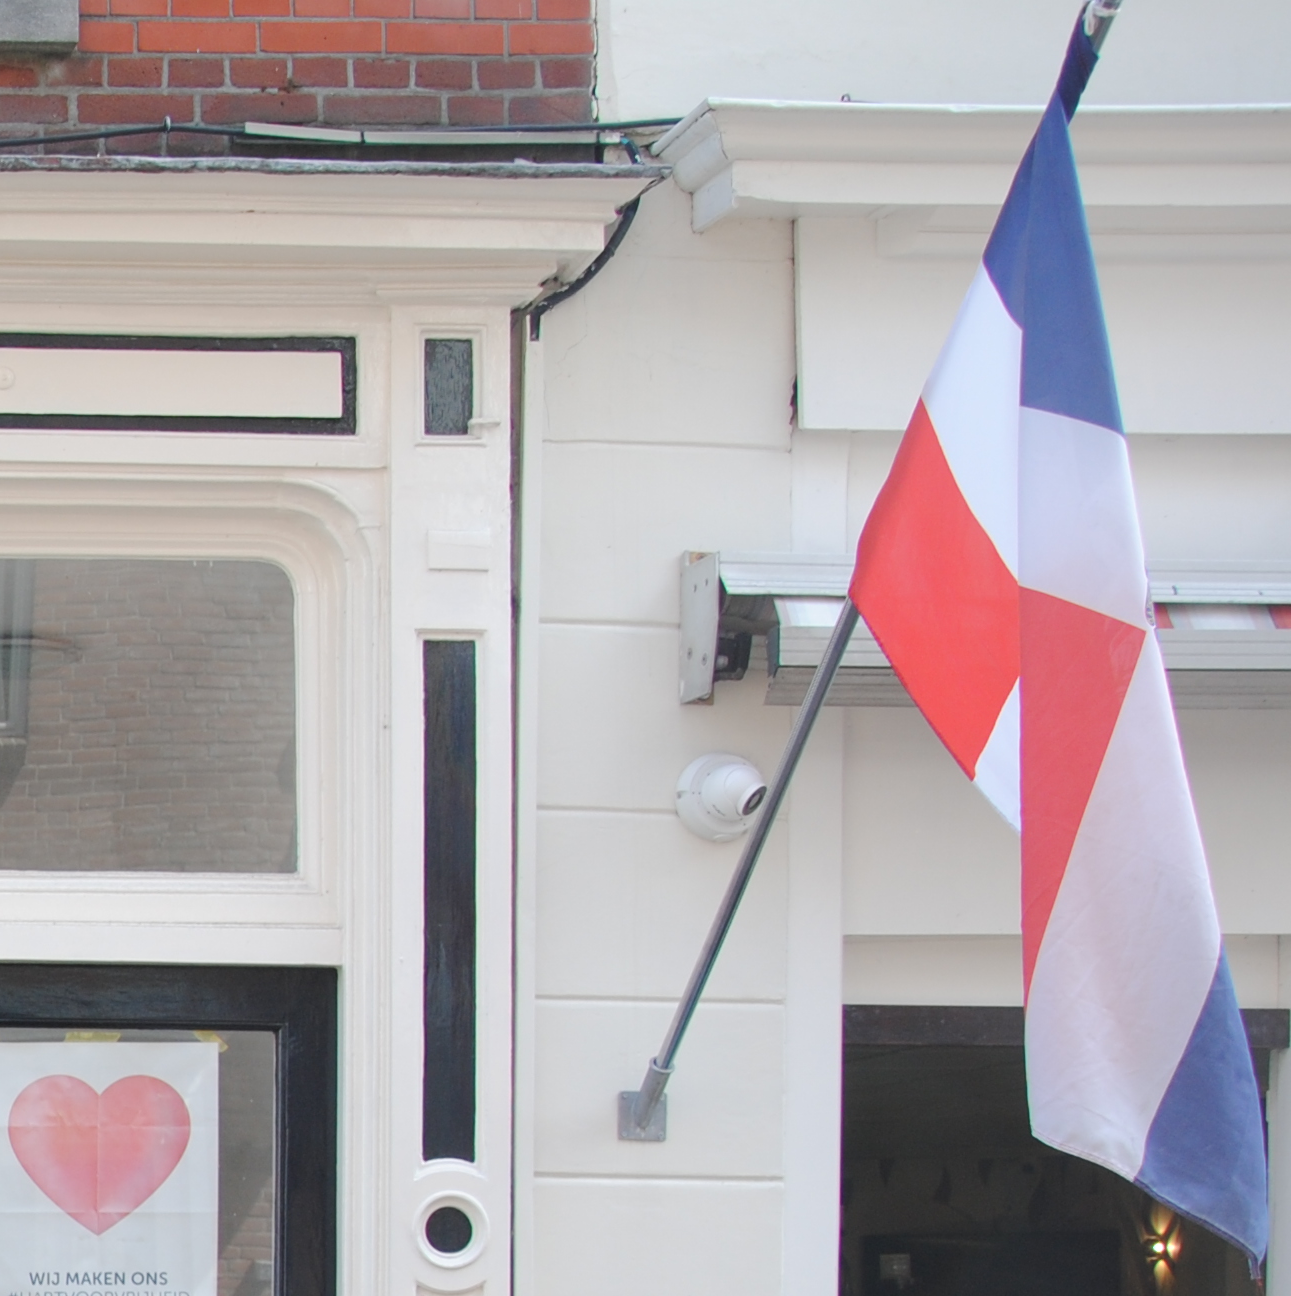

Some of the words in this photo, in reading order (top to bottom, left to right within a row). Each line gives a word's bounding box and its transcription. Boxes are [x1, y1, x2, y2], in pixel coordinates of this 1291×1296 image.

[29, 1271, 60, 1287] WIJ
[65, 1271, 127, 1287] MAKEN
[130, 1271, 169, 1287] ONS
